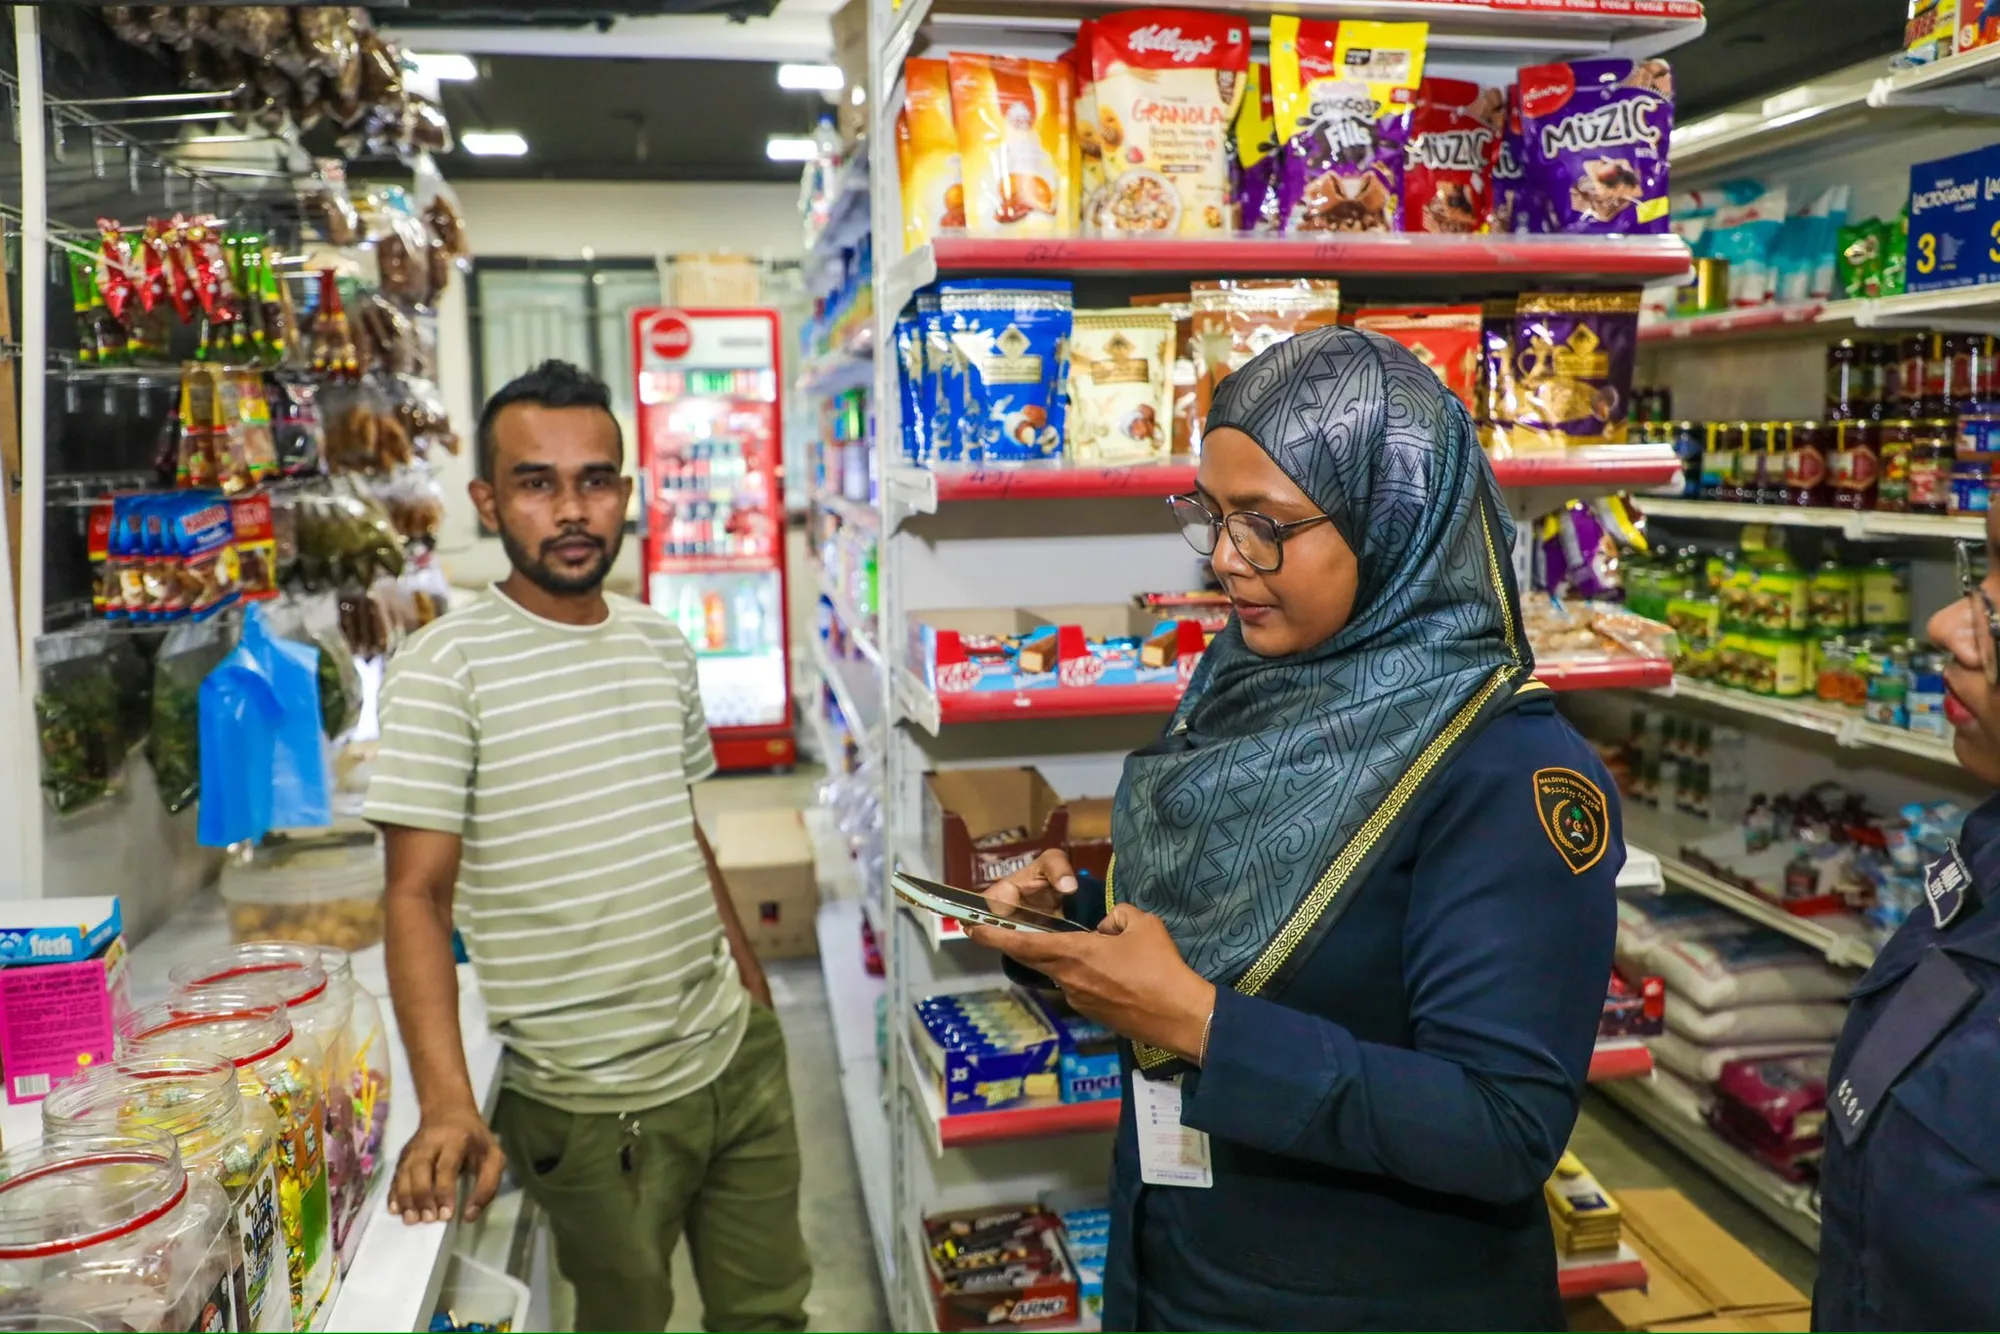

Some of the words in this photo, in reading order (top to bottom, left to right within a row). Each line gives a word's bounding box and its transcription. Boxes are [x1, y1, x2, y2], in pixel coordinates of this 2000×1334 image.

[1128, 24, 1217, 63] Kellogg's
[1131, 98, 1226, 125] GRANOLA
[1916, 233, 1936, 274] 3
[29, 934, 73, 957] fresh
